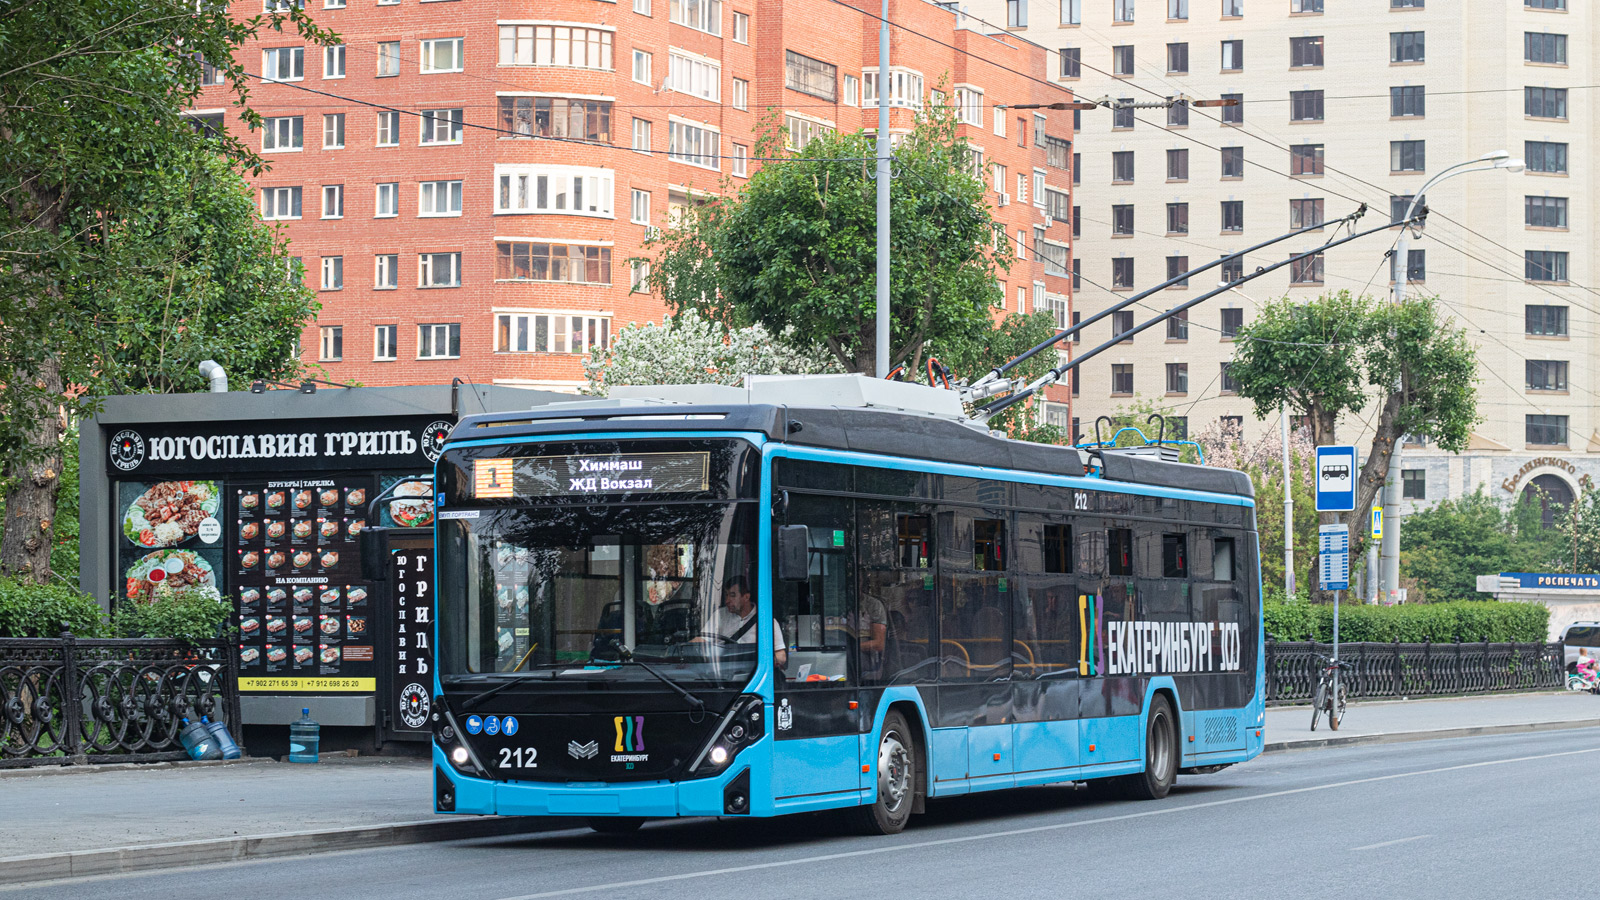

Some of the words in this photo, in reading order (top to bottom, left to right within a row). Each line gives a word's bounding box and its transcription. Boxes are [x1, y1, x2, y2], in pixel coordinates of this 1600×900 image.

[111, 431, 143, 455] ЮГОСЛАВИЯ
[148, 433, 317, 461] ЮГОСЛАВИЯ
[323, 430, 417, 457] ГРИЛЬ
[578, 459, 643, 472] Химмаш
[1501, 456, 1576, 494] Белинского
[267, 480, 300, 488] БУРГЕРЫ
[302, 479, 336, 487] ТАРЕЛКА
[487, 467, 501, 488] 1
[569, 477, 597, 493] ЖД
[600, 477, 653, 490] Вокзал
[1074, 492, 1088, 510] 212
[286, 576, 329, 584] КОМПАНИЮ
[1538, 576, 1599, 587] РОСПЕЧАТЬ
[396, 555, 408, 674] ЮГОСЛАВИЯ
[415, 555, 429, 674] ГРИЛЬ
[1108, 621, 1215, 675] ЕКАТЕРИНБУРГ
[499, 747, 538, 768] 212
[610, 753, 649, 762] ЕКАТЕРИНБУРГ
